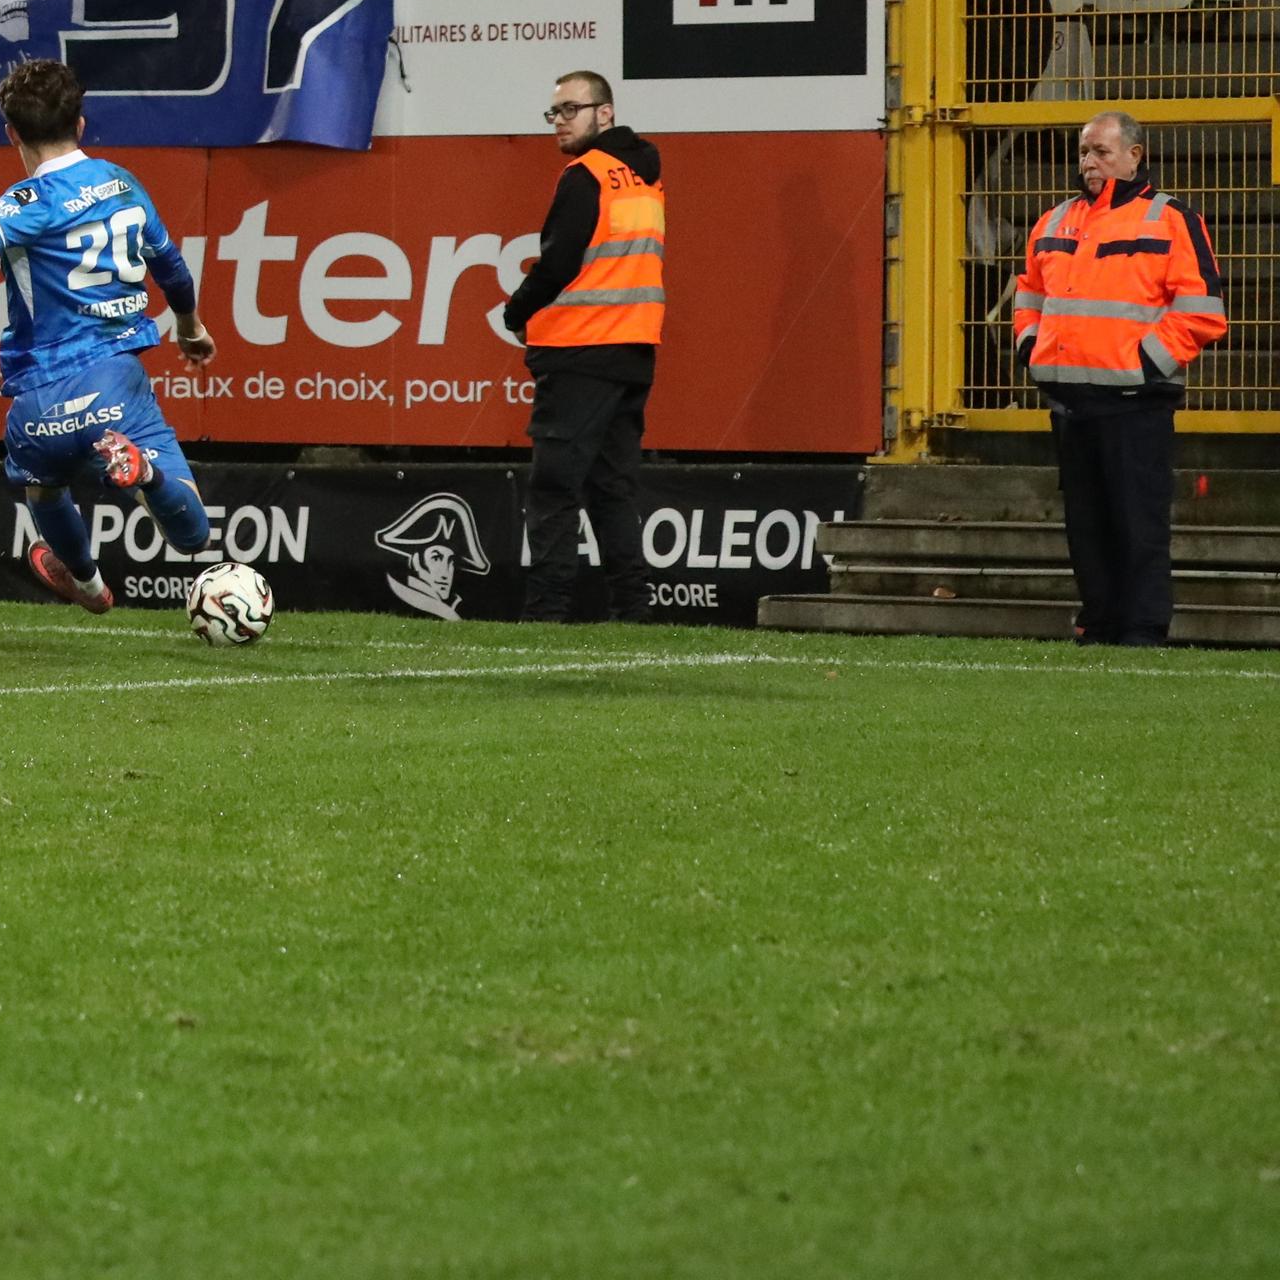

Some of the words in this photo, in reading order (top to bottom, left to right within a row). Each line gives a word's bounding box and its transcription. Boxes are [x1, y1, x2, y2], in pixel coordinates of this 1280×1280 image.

[395, 24, 466, 44] ILITAIRES
[471, 24, 482, 42] &
[487, 23, 509, 41] DE
[513, 21, 597, 41] TOURISME
[66, 206, 148, 290] 20
[77, 291, 149, 319] KARETSAS
[150, 370, 234, 399] riaux
[244, 371, 285, 400] de
[295, 372, 395, 407] choix,
[405, 380, 493, 408] pour
[503, 376, 536, 404] to
[24, 404, 125, 436] CARGLASS
[646, 583, 719, 608] SCORE
